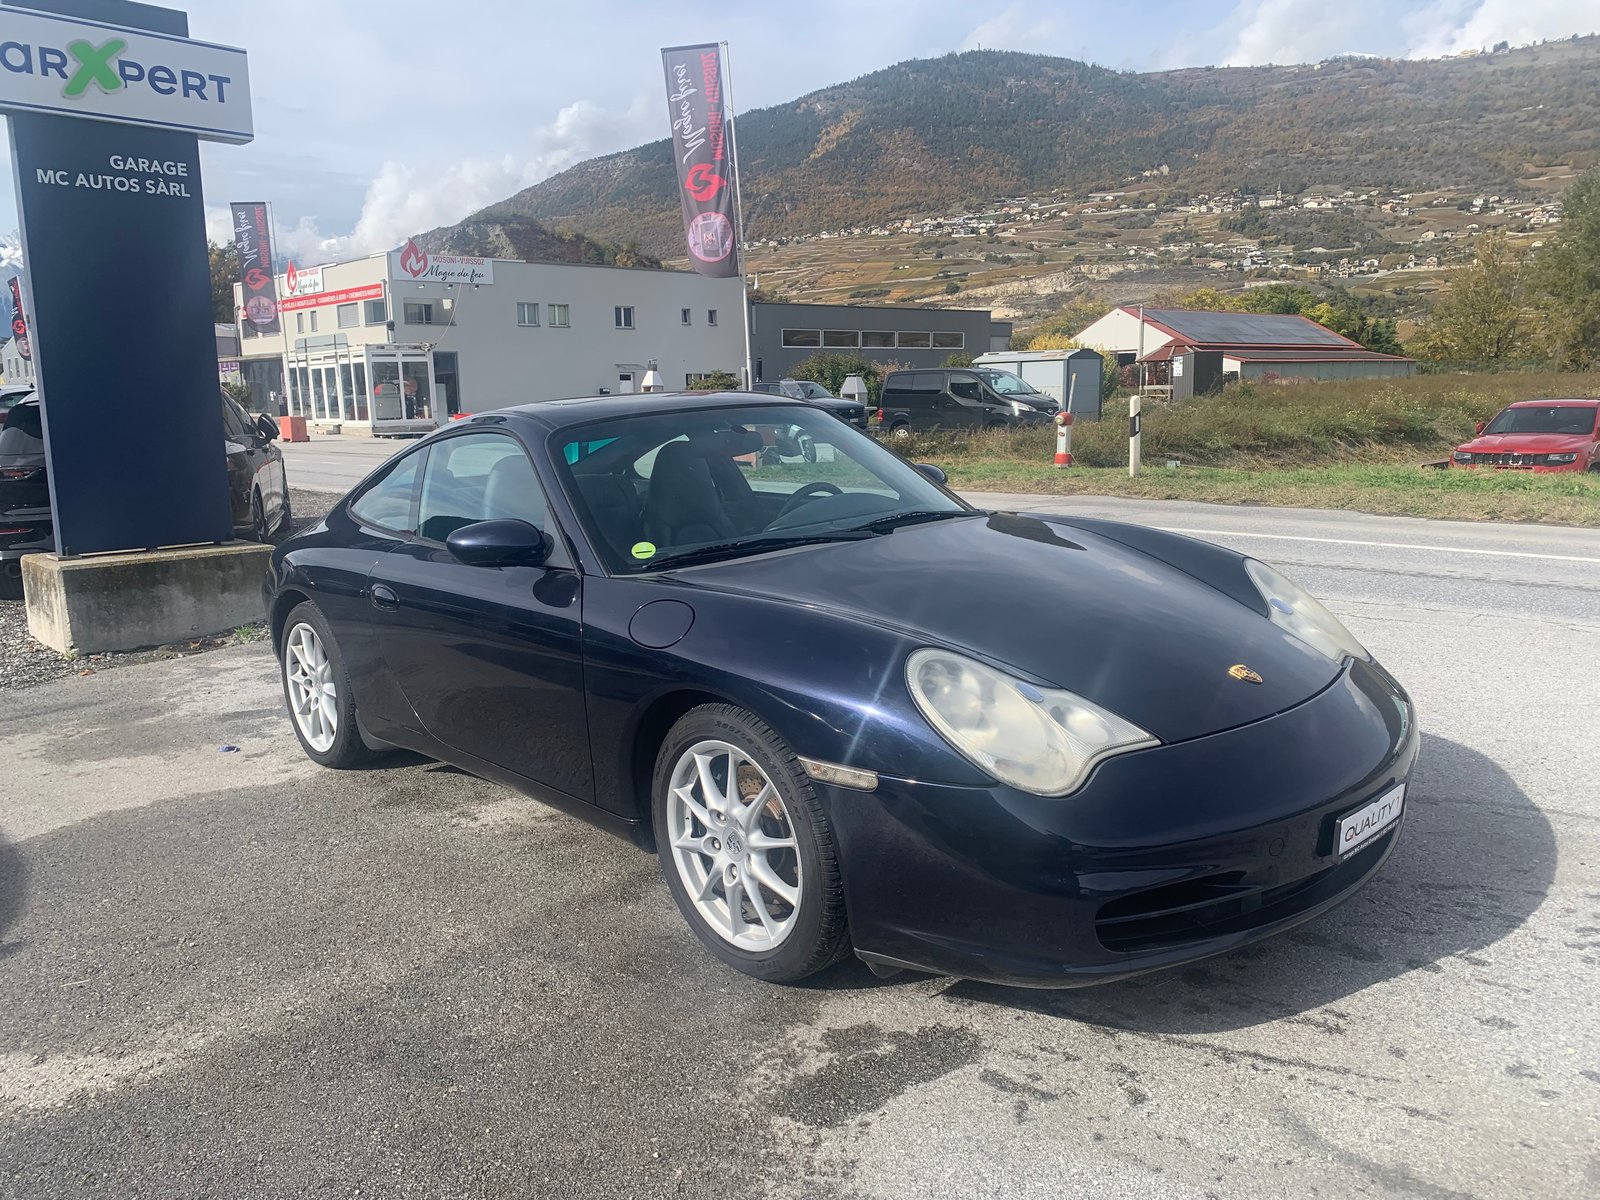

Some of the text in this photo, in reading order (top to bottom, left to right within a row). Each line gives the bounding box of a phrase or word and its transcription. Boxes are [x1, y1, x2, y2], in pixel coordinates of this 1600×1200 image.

[109, 155, 188, 177] GARAGE
[36, 169, 191, 197] MC AUTOS SÀRL
[422, 264, 485, 283] Magie du feu
[1345, 799, 1396, 842] QUALITY
